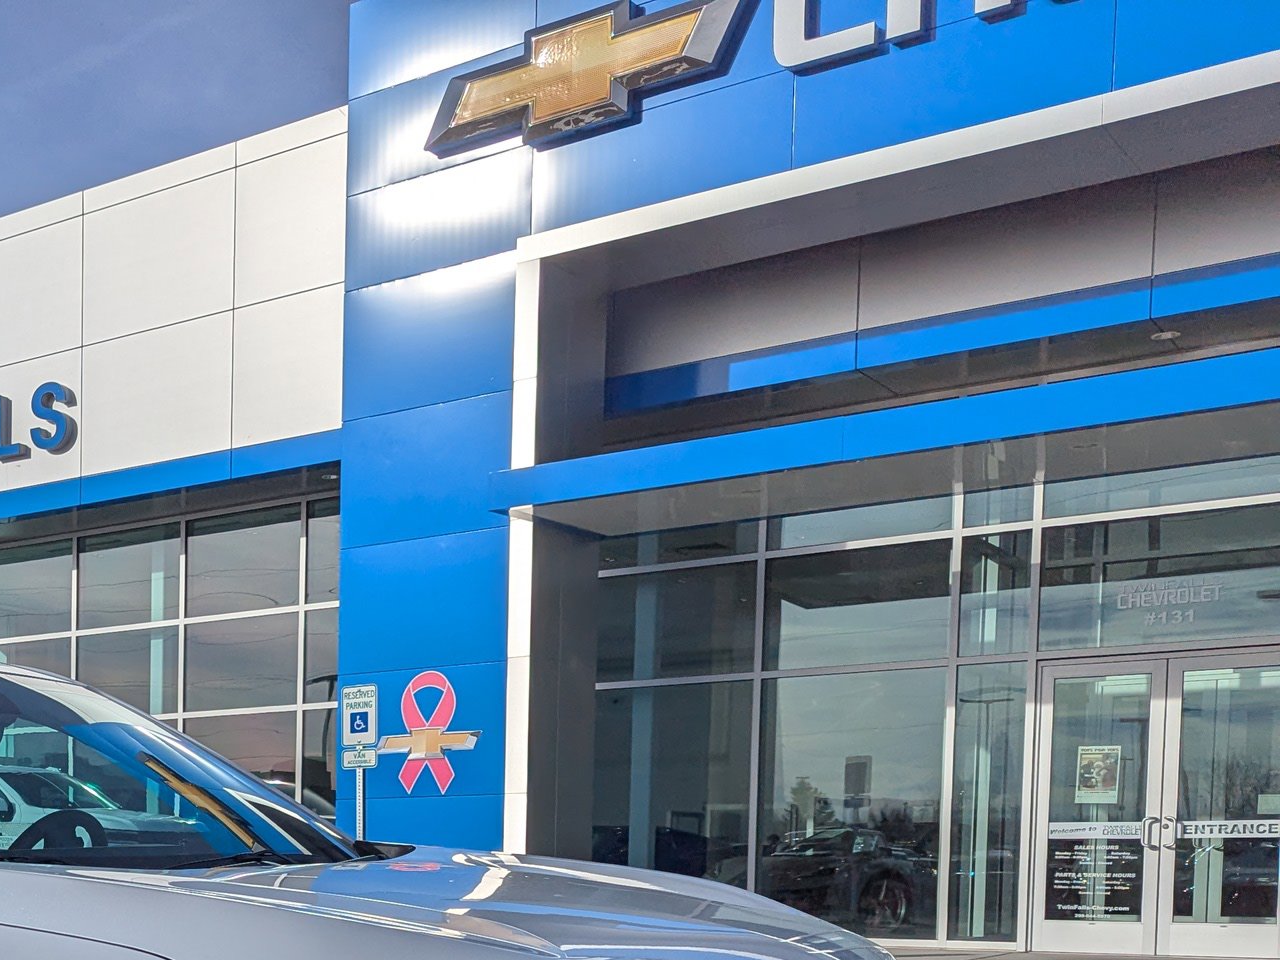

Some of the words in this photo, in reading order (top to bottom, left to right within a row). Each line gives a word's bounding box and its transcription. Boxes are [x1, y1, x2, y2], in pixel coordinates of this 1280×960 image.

[1117, 584, 1223, 609] CHEVROLET
[1144, 609, 1195, 626] #131
[344, 689, 375, 700] RESERVED
[345, 701, 373, 710] PARKING
[1183, 823, 1279, 834] ENTRANCE
